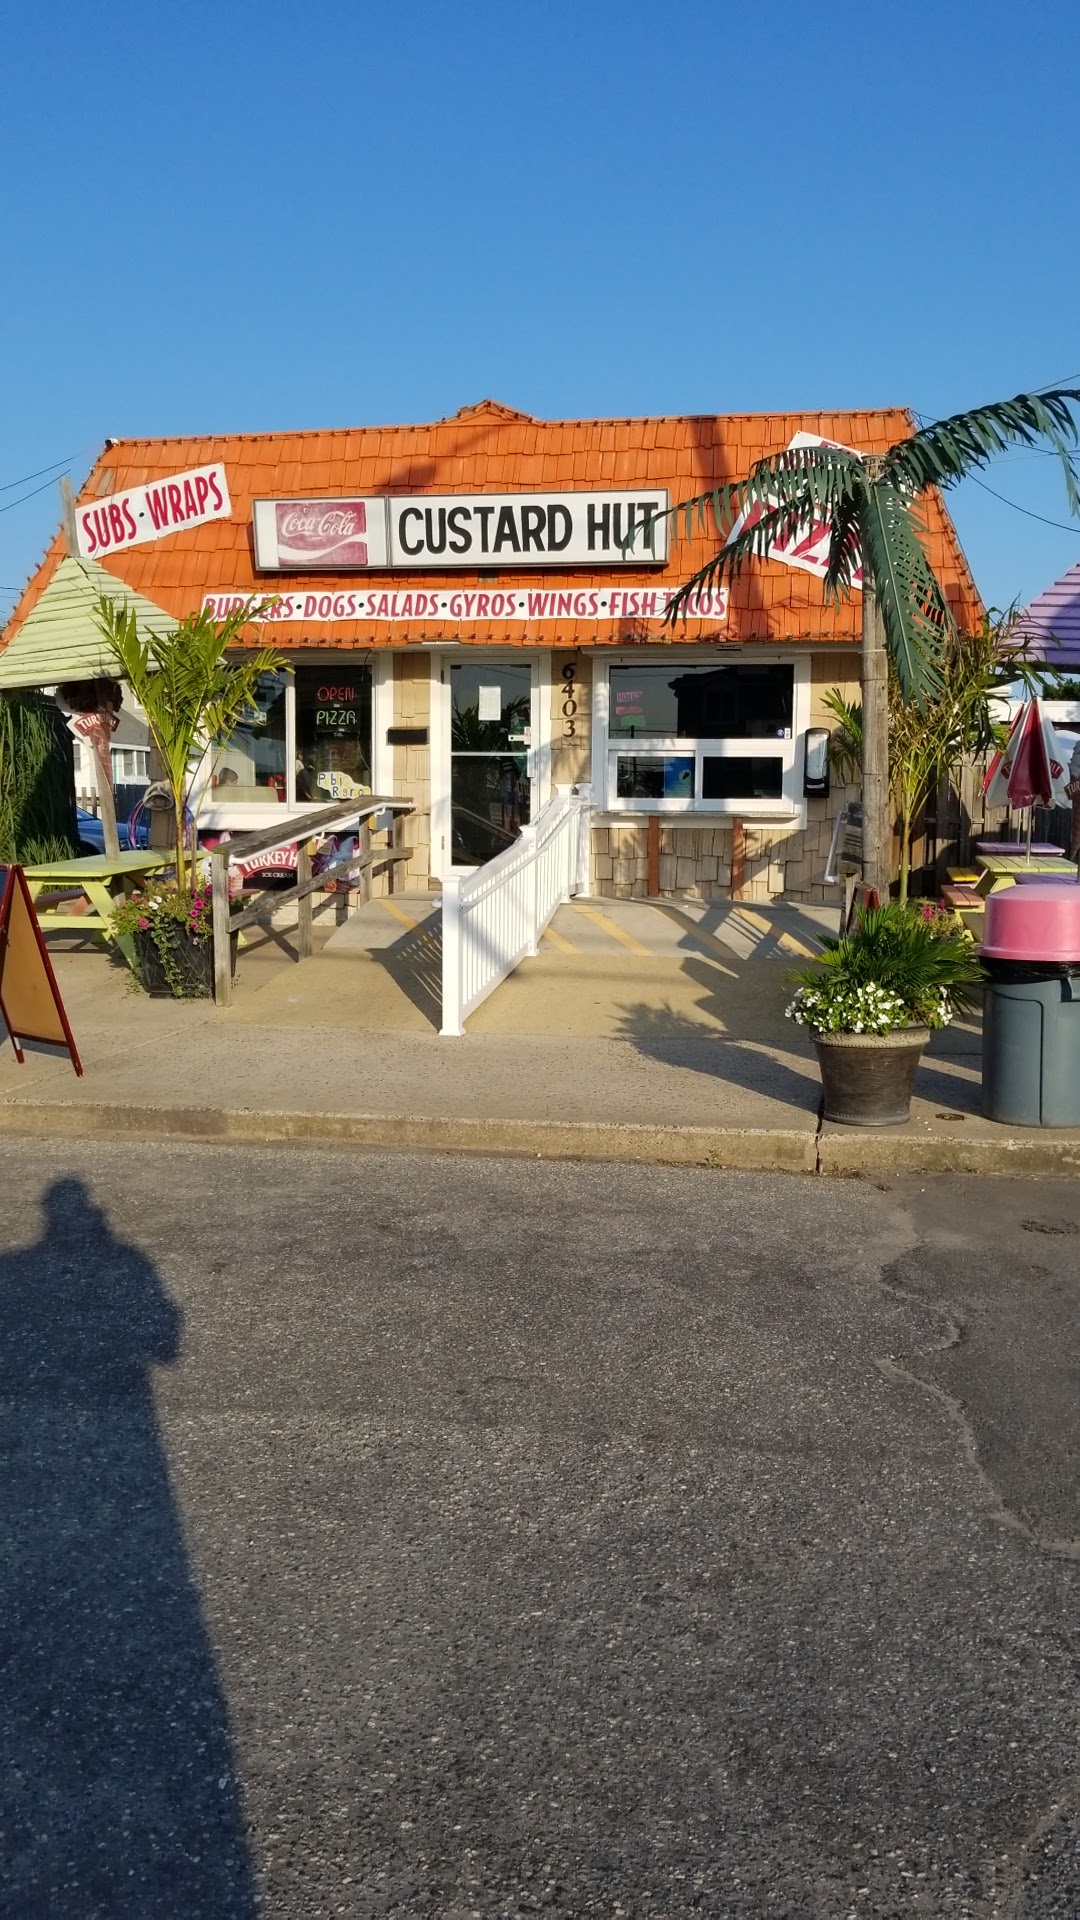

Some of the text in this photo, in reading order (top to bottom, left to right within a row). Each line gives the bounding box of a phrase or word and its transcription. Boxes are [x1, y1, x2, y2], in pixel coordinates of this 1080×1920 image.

[82, 471, 223, 553] SUBS WRAPS
[398, 502, 659, 556] CUSTARD HUT
[303, 594, 356, 618] DOGS
[365, 593, 439, 617] SALADS
[450, 593, 516, 617] GYROS
[528, 592, 598, 617] WINGS
[609, 592, 657, 616] FISH
[317, 686, 355, 702] OPEN
[316, 710, 357, 725] PIZZA
[243, 850, 289, 872] TURKEY
